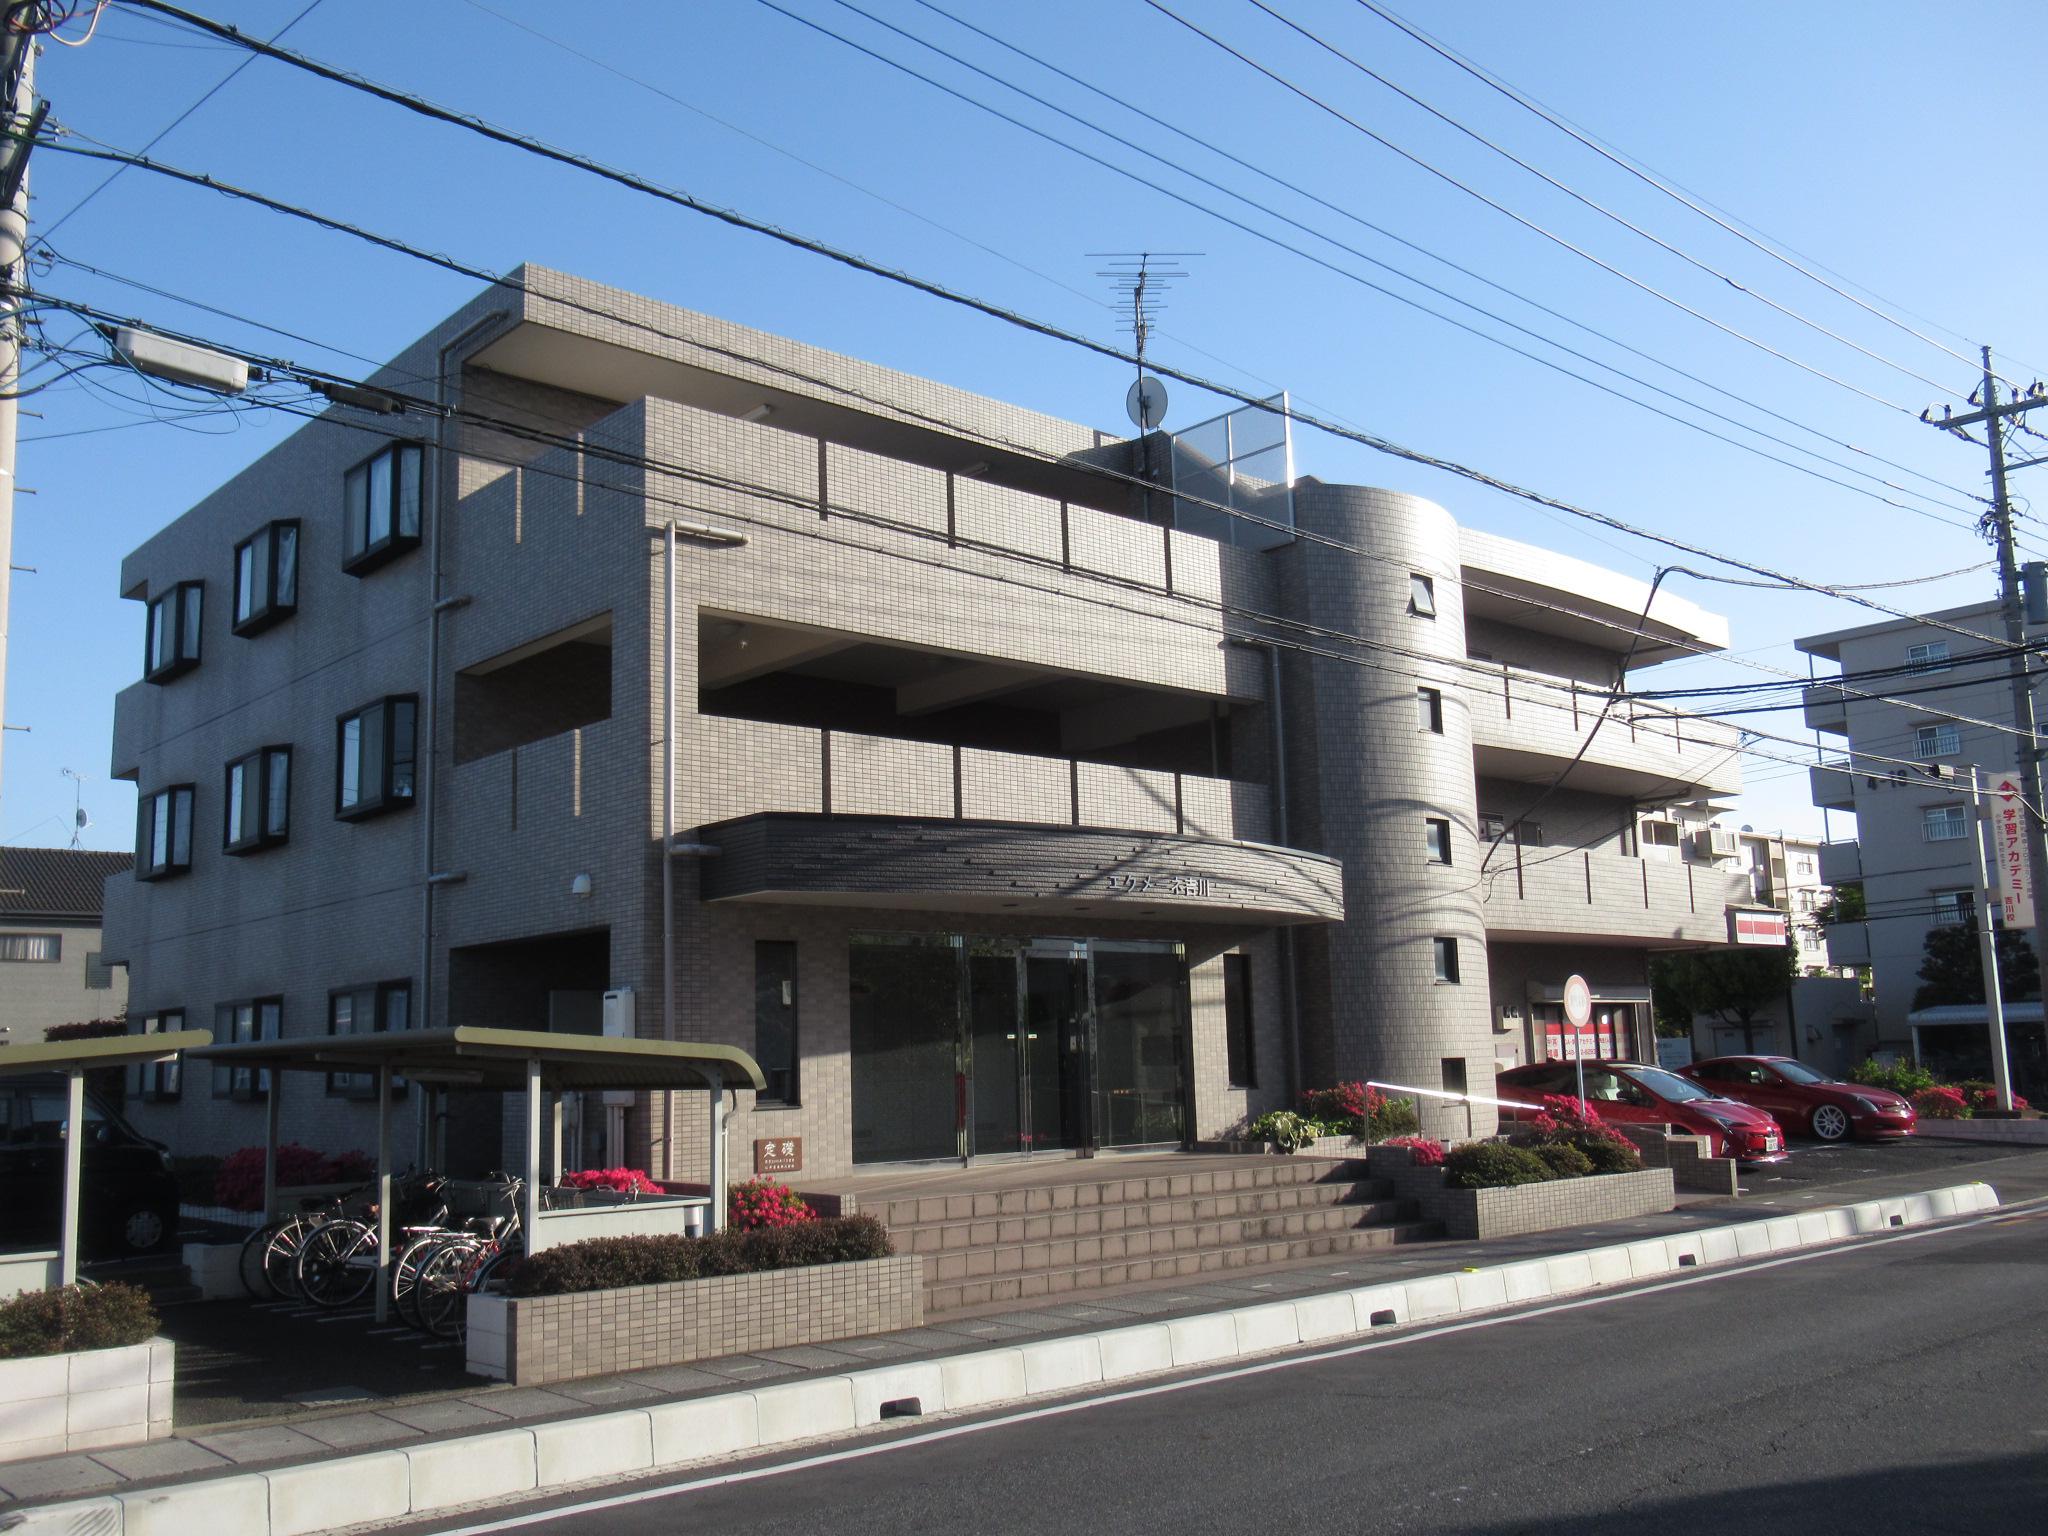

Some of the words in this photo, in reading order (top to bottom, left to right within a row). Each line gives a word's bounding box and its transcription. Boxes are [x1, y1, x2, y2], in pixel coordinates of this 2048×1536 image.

[1107, 874, 1210, 897] エクメーネ吉川
[2003, 808, 2023, 904] 学習アカデミー
